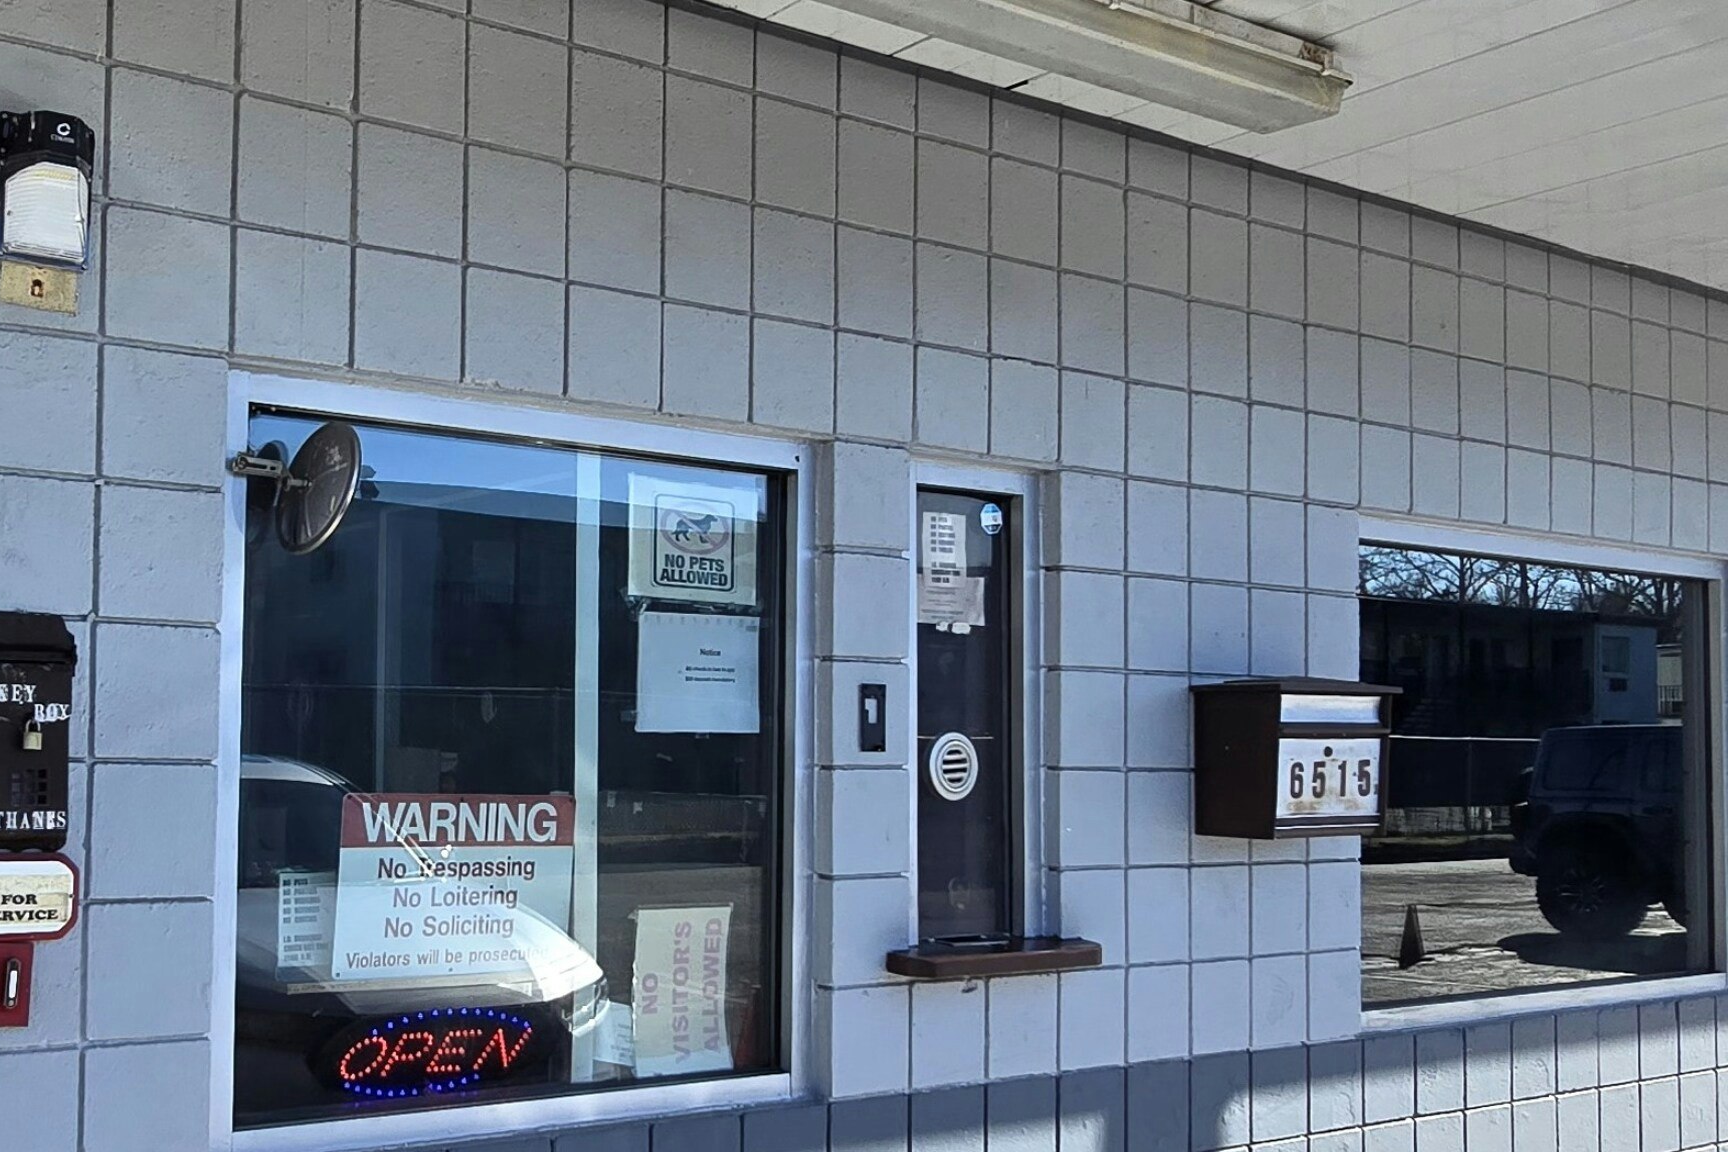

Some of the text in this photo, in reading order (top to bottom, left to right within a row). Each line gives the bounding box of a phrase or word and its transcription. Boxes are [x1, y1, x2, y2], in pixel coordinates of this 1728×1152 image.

[665, 553, 725, 573] NO PETS
[660, 568, 728, 587] ALLOWED
[34, 704, 69, 722] BOX
[1289, 759, 1371, 799] 6515
[362, 802, 558, 843] WARNING
[377, 857, 407, 879] No
[0, 894, 38, 905] FOR
[393, 885, 518, 909] No Loitering
[384, 914, 515, 938] No Soliciting
[346, 951, 411, 970] Violators
[417, 949, 439, 965] will
[445, 948, 463, 964] be
[641, 972, 659, 1015] NO
[672, 920, 693, 1065] VISITOR'S
[702, 917, 722, 1051] ALLOWED
[340, 1027, 533, 1080] OPEN
